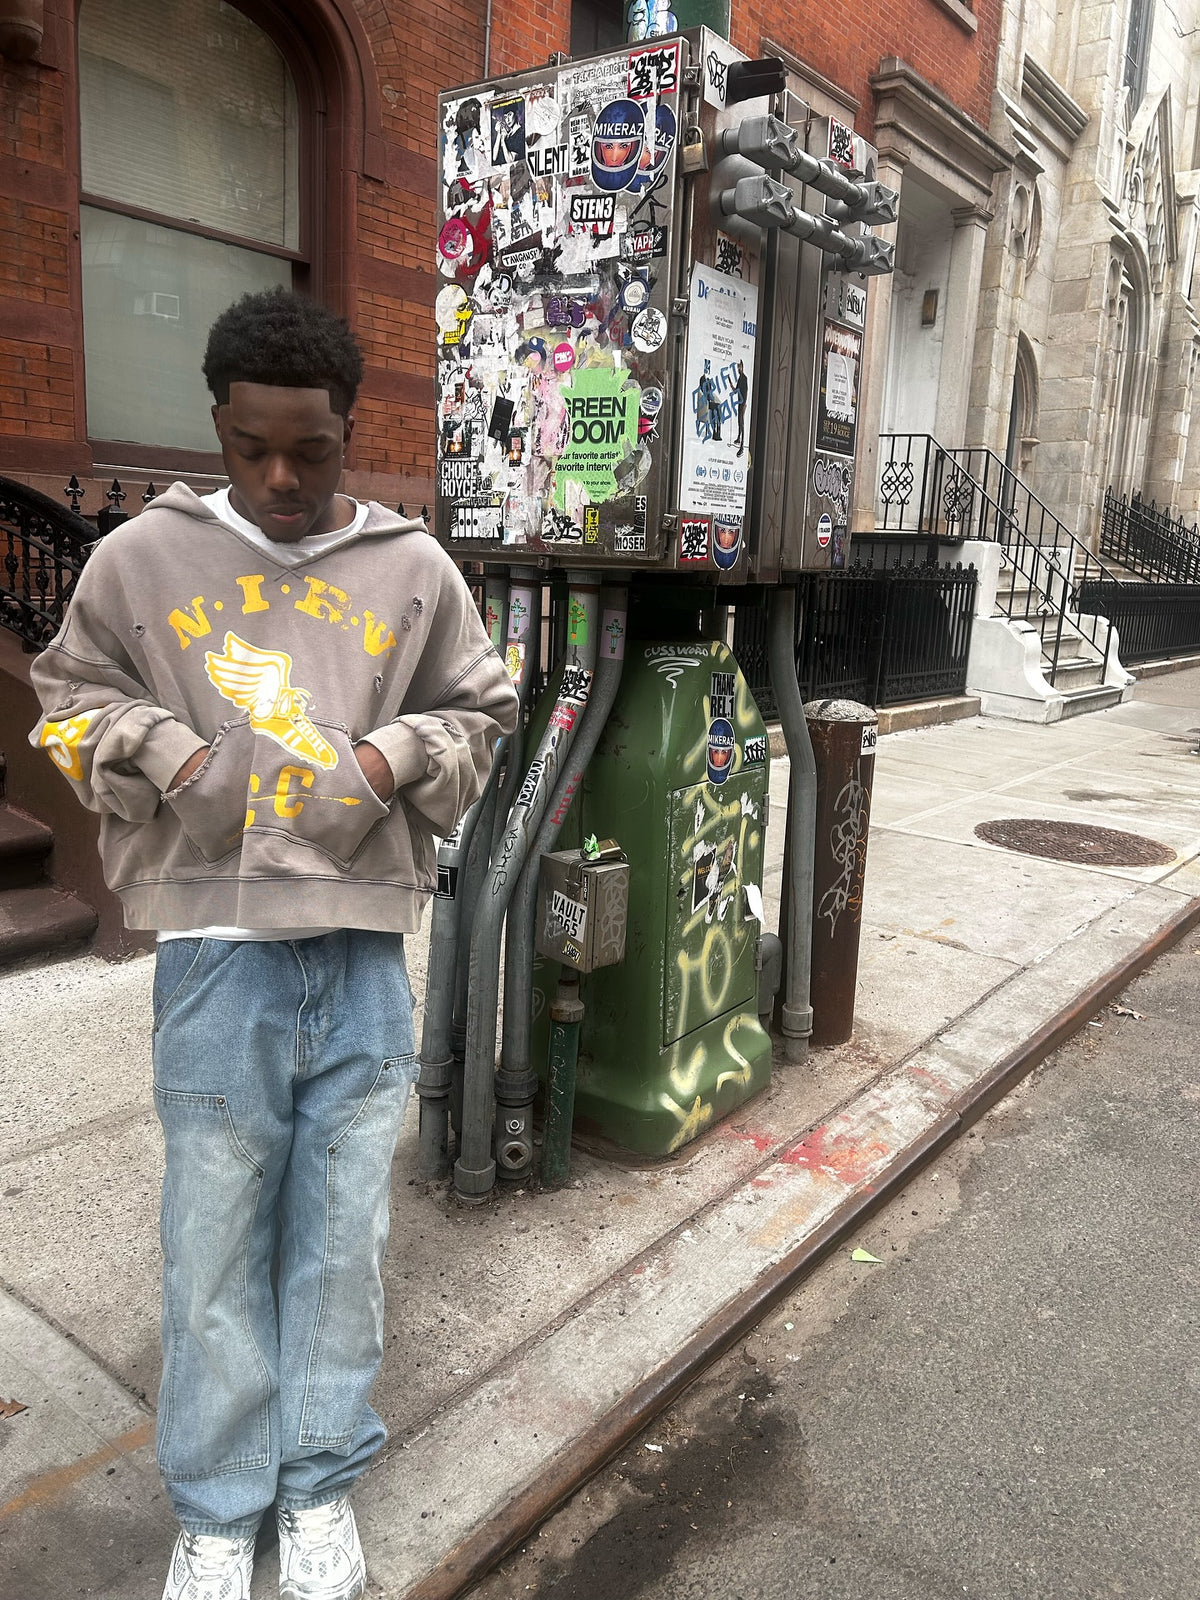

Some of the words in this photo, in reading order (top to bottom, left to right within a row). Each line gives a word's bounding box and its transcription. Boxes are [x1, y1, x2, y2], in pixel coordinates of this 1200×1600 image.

[527, 145, 568, 177] SILENT
[572, 197, 614, 220] STEN3
[571, 420, 626, 444] OOM
[572, 451, 599, 460] favorite
[441, 461, 477, 480] CHOICE
[586, 462, 612, 472] intervi
[441, 479, 477, 497] ROYCE
[615, 537, 645, 550] MOSER
[553, 894, 586, 925] VAULT
